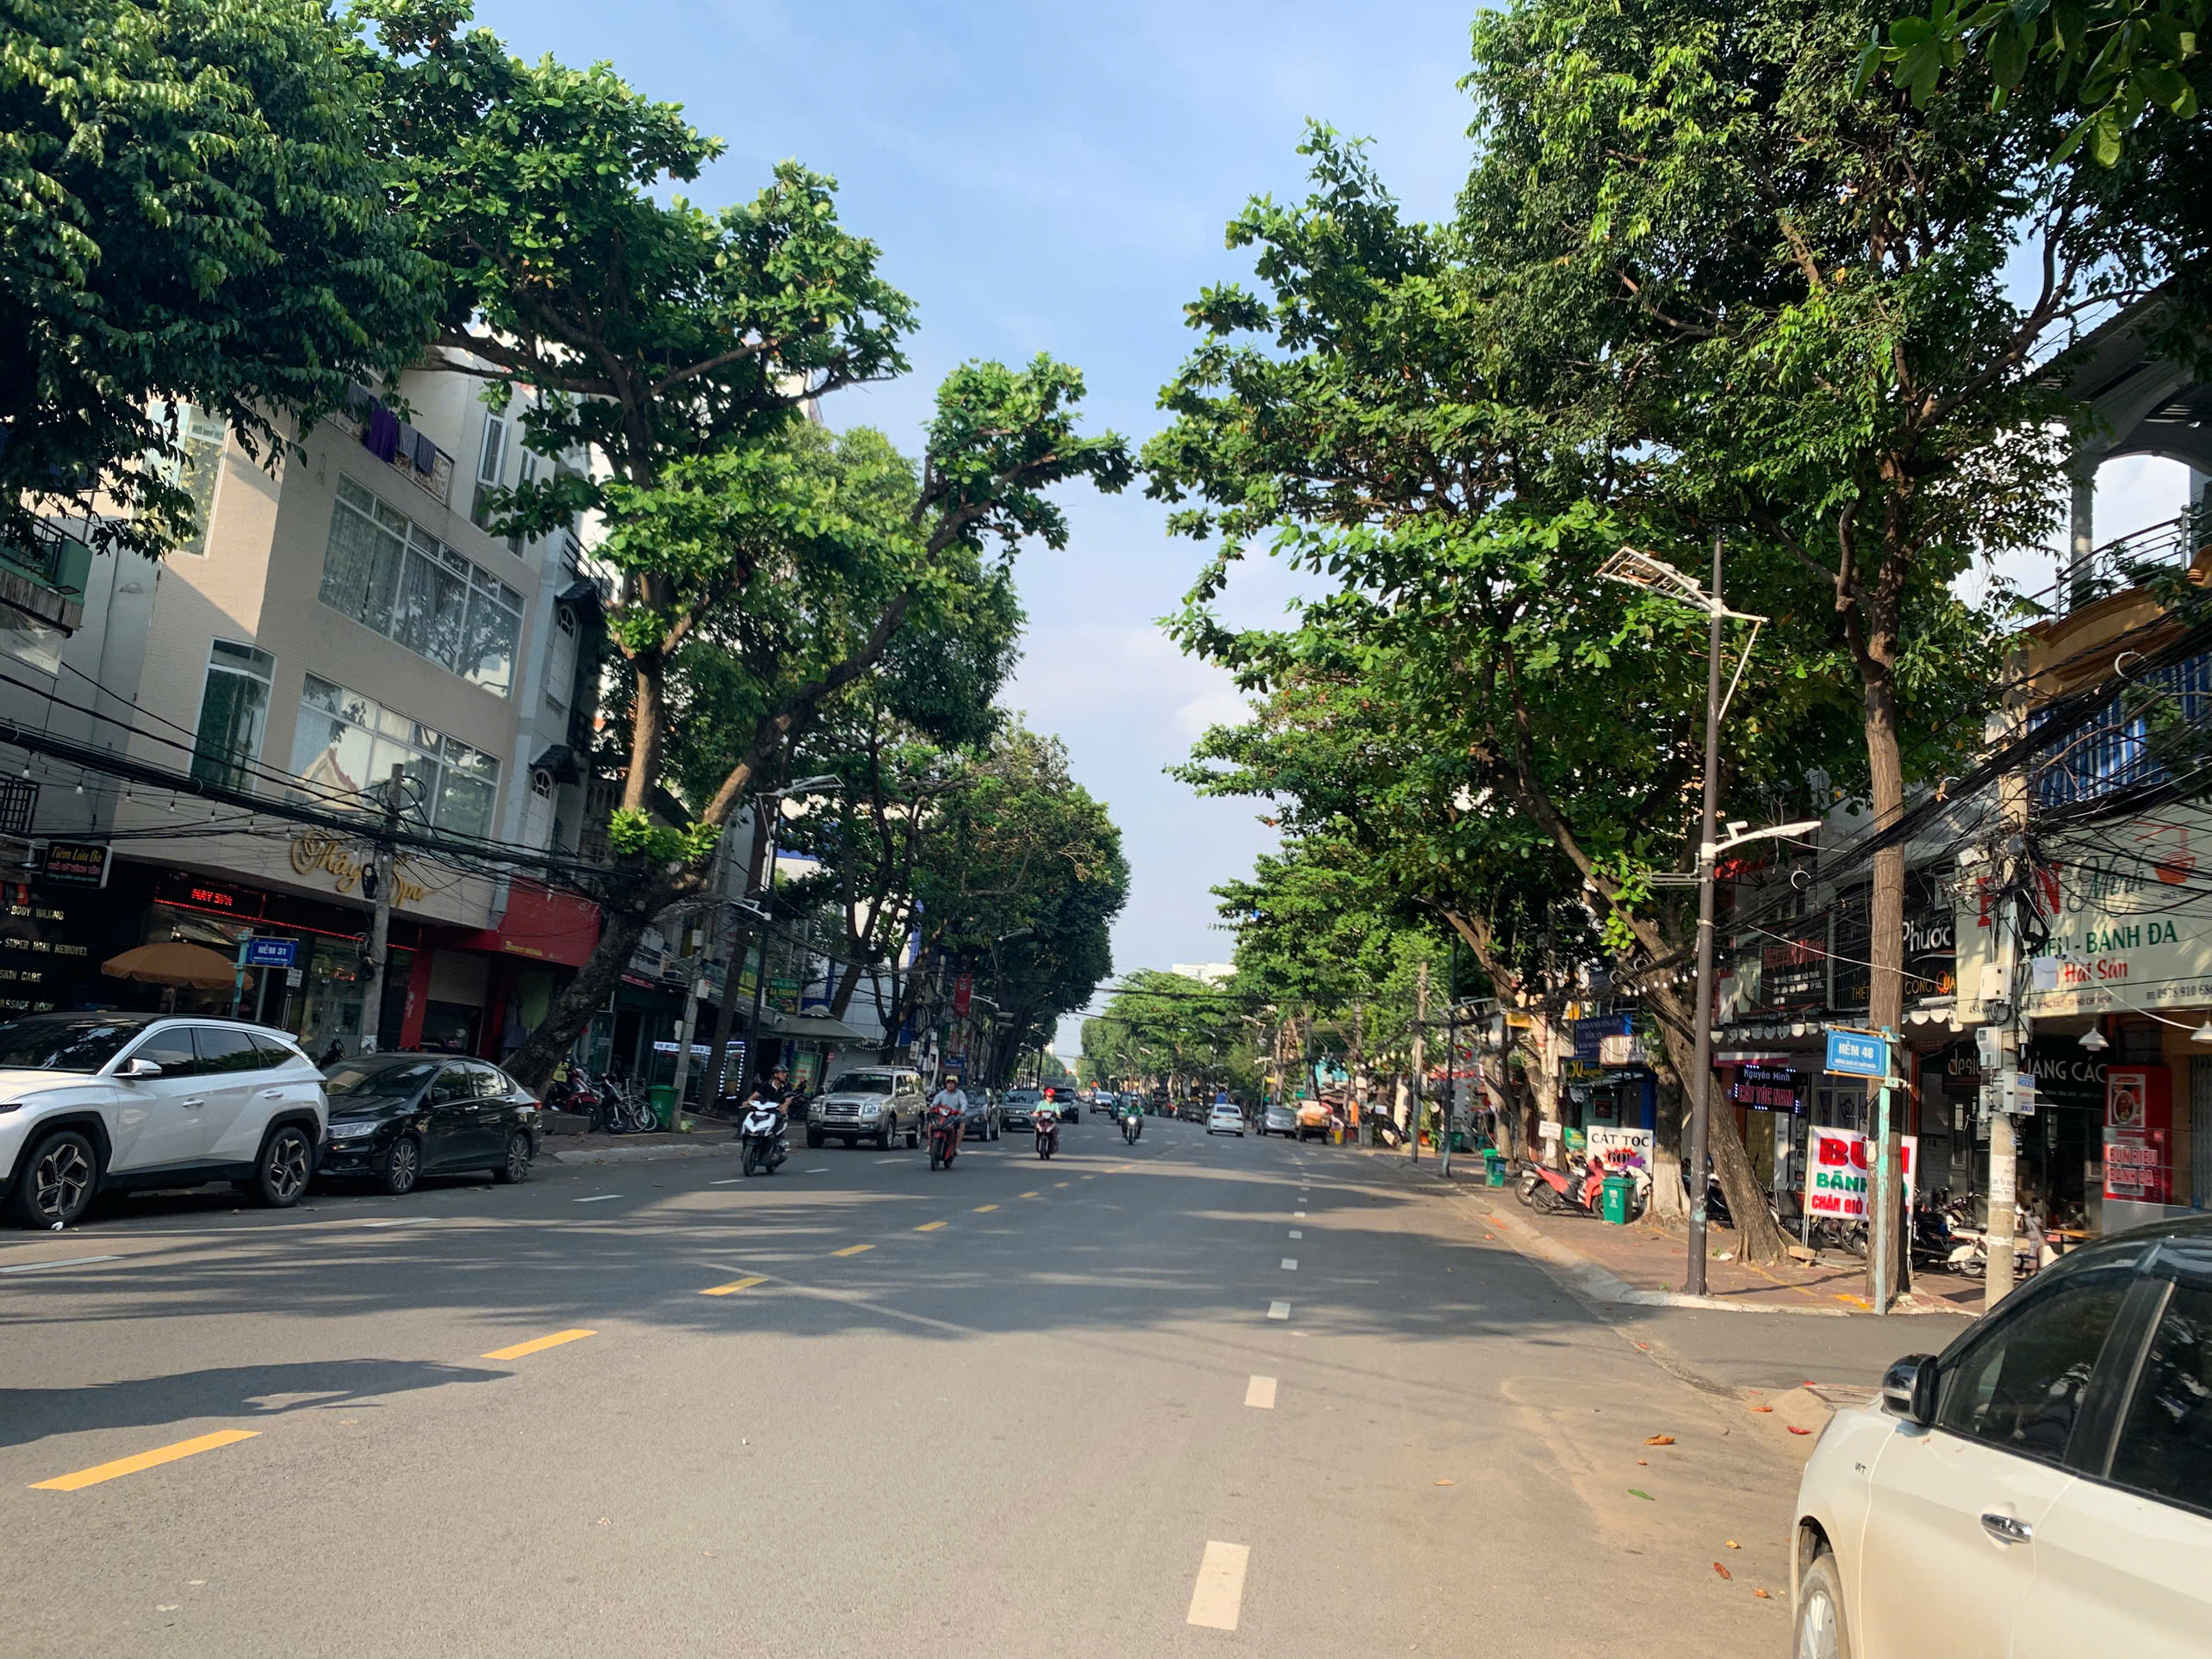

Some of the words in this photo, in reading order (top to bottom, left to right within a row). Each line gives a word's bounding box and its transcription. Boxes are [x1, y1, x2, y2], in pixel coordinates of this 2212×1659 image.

[10, 905, 31, 916] BODY
[2147, 920, 2178, 946] ĐA
[4, 938, 29, 950] SUPER
[277, 948, 287, 956] 31
[0, 969, 16, 980] SKIN
[21, 971, 41, 982] CARE
[0, 999, 29, 1010] ASSAGE
[34, 1002, 54, 1011] BODY
[1839, 1041, 1860, 1057] HẺM
[1861, 1047, 1874, 1059] 48
[2027, 1051, 2066, 1080] ẢNG
[1773, 1071, 1791, 1082] Minh
[1756, 1084, 1772, 1105] TÓC
[1773, 1088, 1794, 1107] NAM
